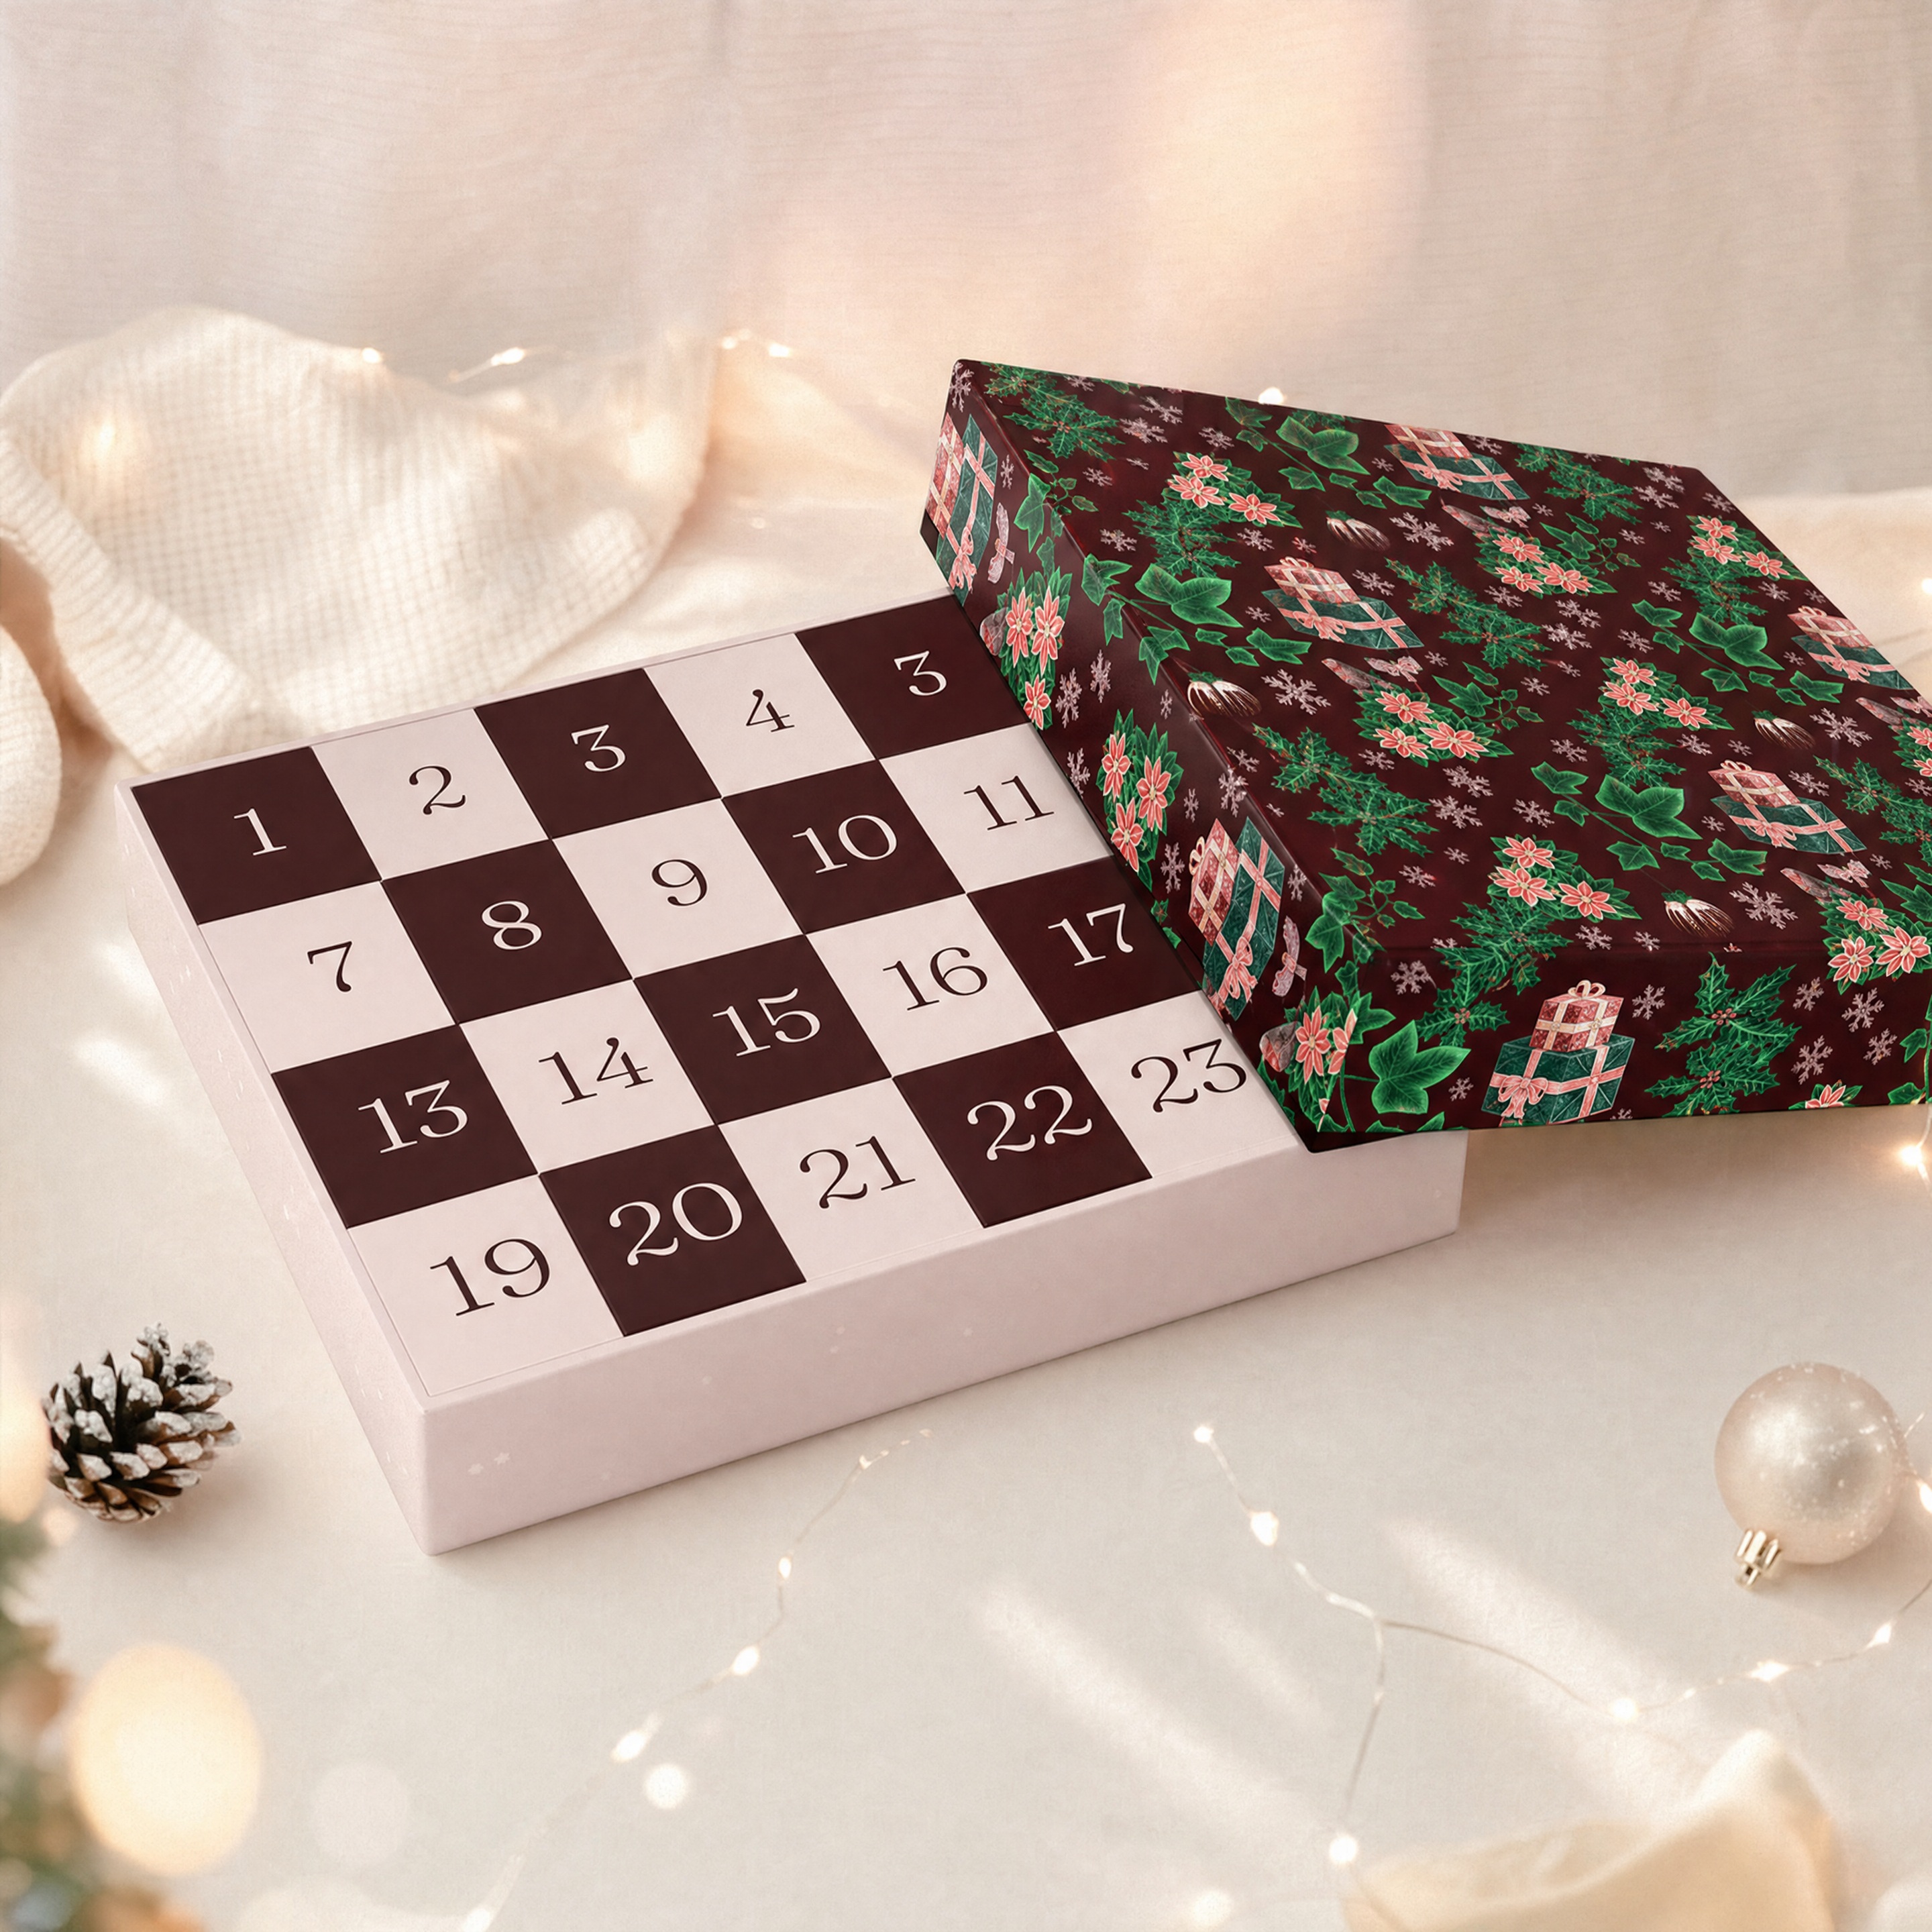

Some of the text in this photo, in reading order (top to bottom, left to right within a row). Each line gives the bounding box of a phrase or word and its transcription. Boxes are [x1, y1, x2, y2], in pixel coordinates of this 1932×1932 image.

[894, 651, 947, 696] 3
[745, 689, 795, 733] 4
[571, 724, 625, 772] 3
[409, 765, 466, 815] 2
[963, 775, 1055, 830] 11
[233, 808, 287, 856] 1
[792, 814, 897, 873] 10
[651, 859, 708, 906] 9
[482, 901, 542, 950] 8
[1048, 903, 1134, 966] 17
[307, 941, 352, 992] 7
[883, 947, 987, 1011] 16
[712, 988, 820, 1057] 15
[538, 1037, 653, 1105] 14
[1131, 1038, 1247, 1113] 23
[358, 1079, 468, 1153] 13
[967, 1085, 1092, 1161] 22
[800, 1136, 916, 1209] 21
[609, 1183, 743, 1266] 20
[430, 1238, 550, 1316] 19
